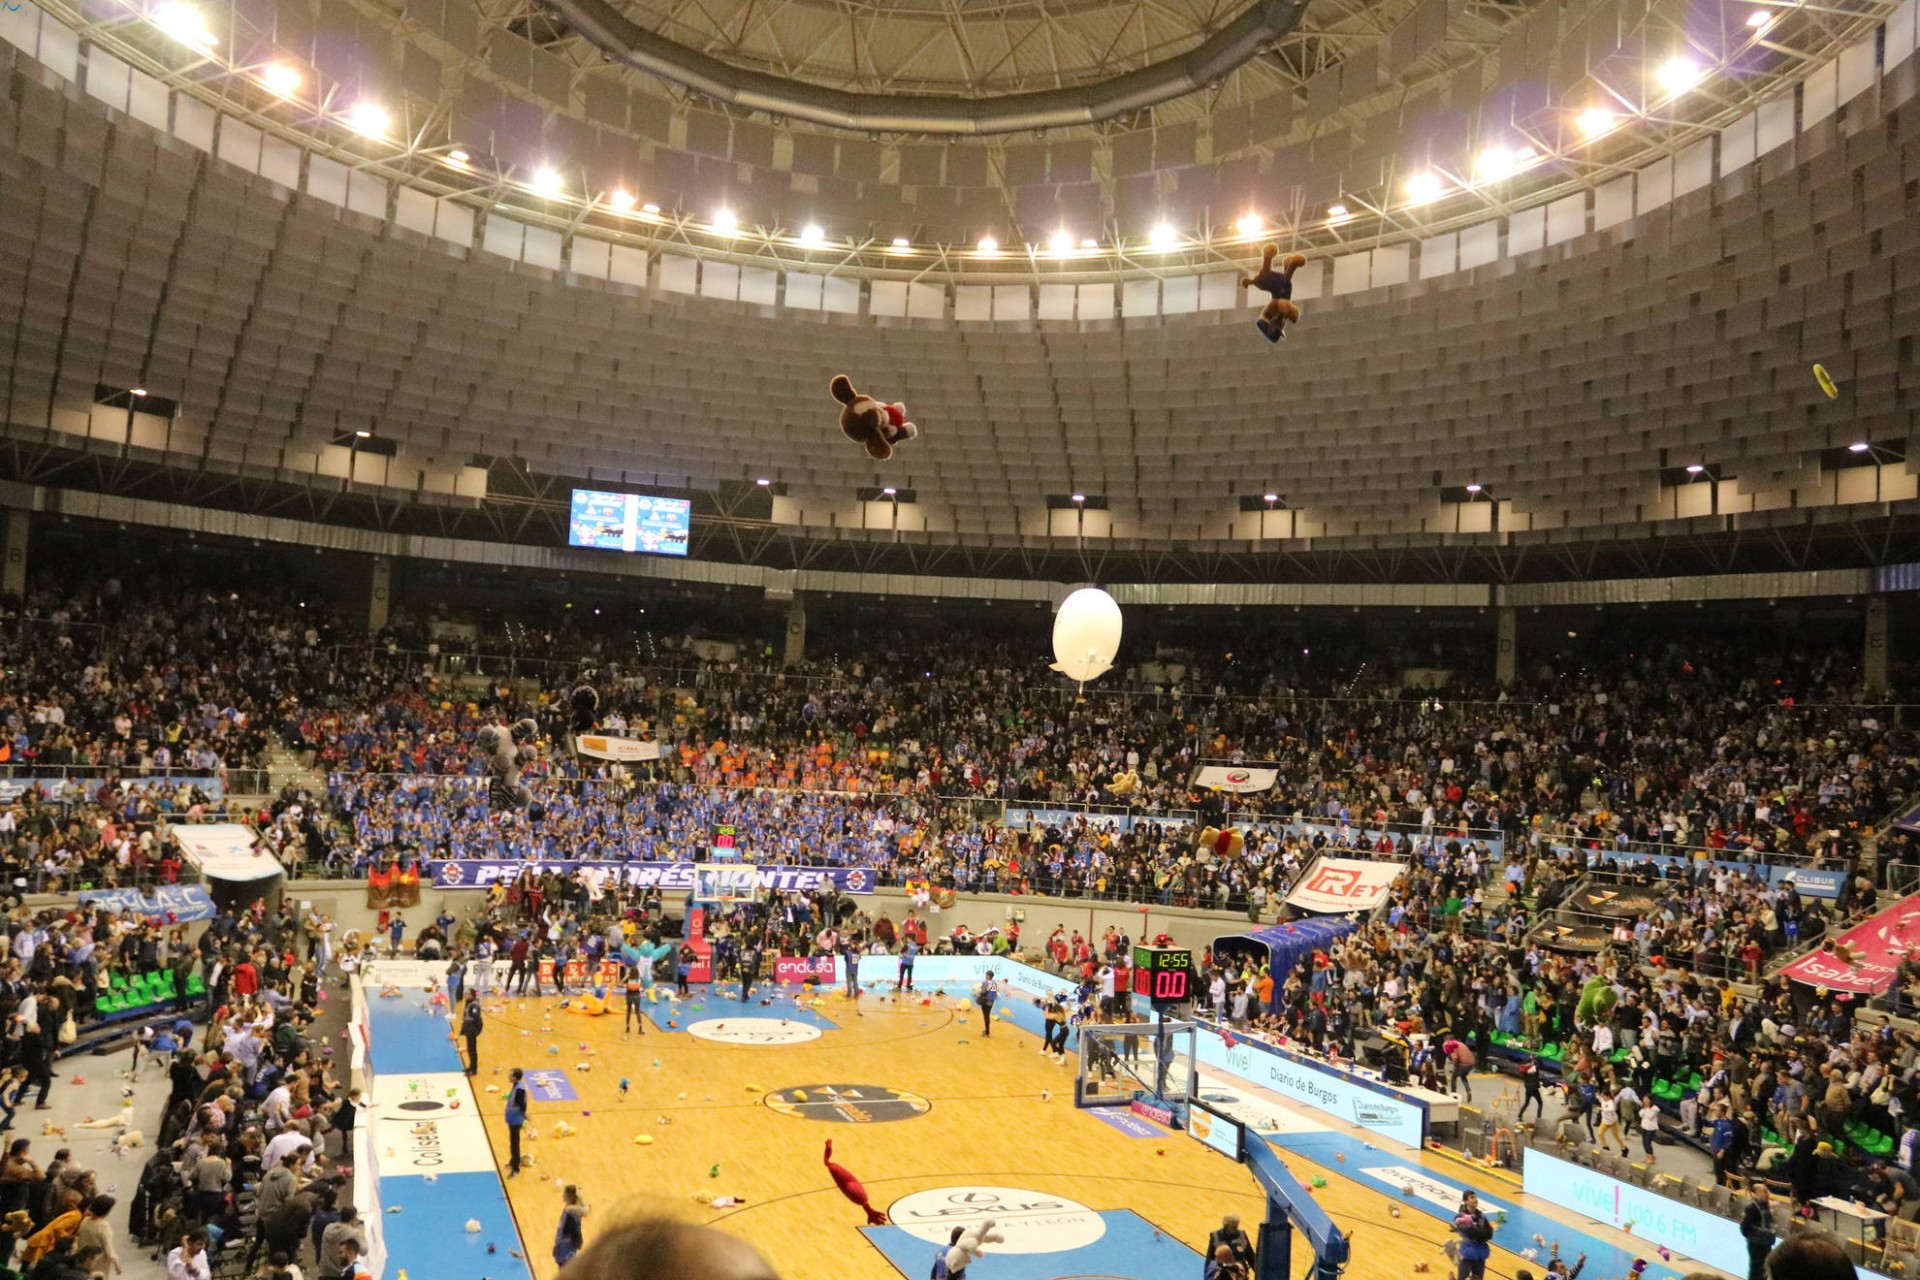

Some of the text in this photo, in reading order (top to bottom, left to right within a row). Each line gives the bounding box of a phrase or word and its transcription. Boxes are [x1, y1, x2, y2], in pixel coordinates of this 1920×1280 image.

[1796, 875, 1835, 884] CLIBUR
[1159, 953, 1189, 967] 12:55
[1270, 1067, 1337, 1104] Diario de Burgos
[909, 1202, 1064, 1218] LEXUS
[1573, 1181, 1619, 1223] vive!
[1671, 1219, 1698, 1245] FM
